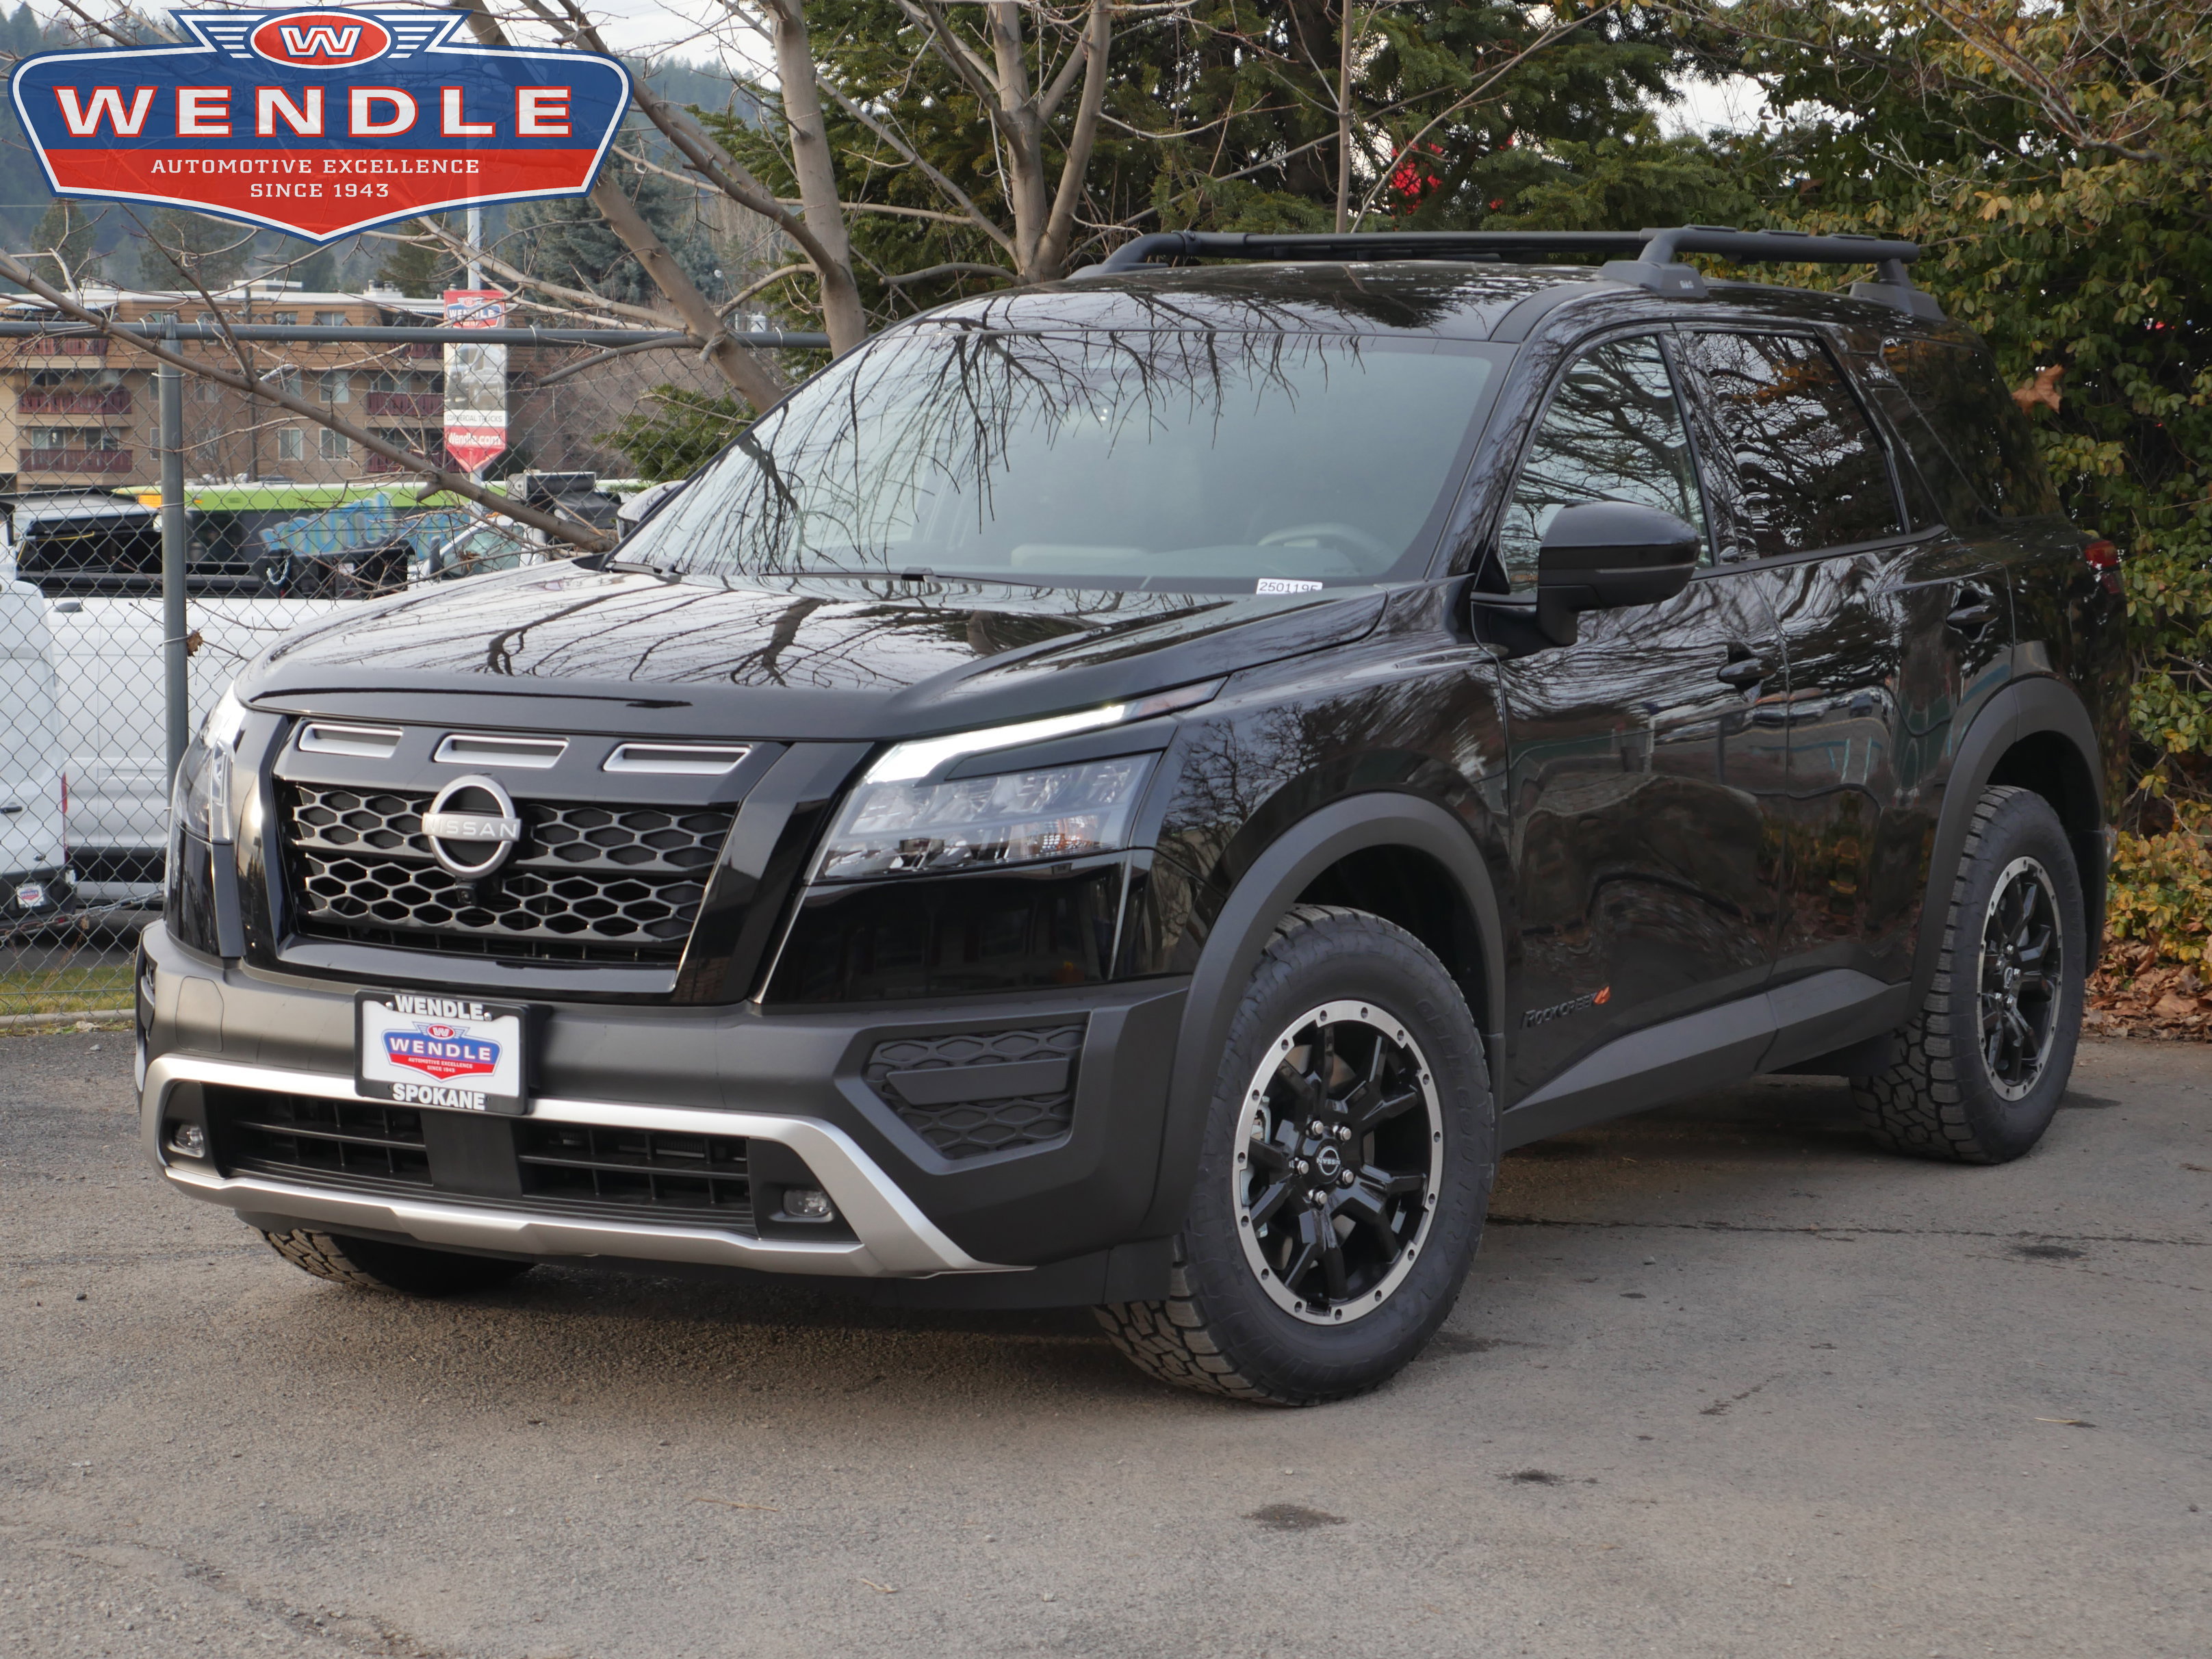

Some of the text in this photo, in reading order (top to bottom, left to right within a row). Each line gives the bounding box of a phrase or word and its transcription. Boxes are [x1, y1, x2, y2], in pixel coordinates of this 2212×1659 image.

[448, 432, 501, 446] Wendle.com
[424, 818, 517, 838] NISSAN
[395, 994, 485, 1022] WENDLE
[389, 1038, 491, 1061] WENDLE
[408, 1057, 474, 1069] AUTOMOTIVE EXCELLENCE
[393, 1083, 485, 1111] SPOKANE
